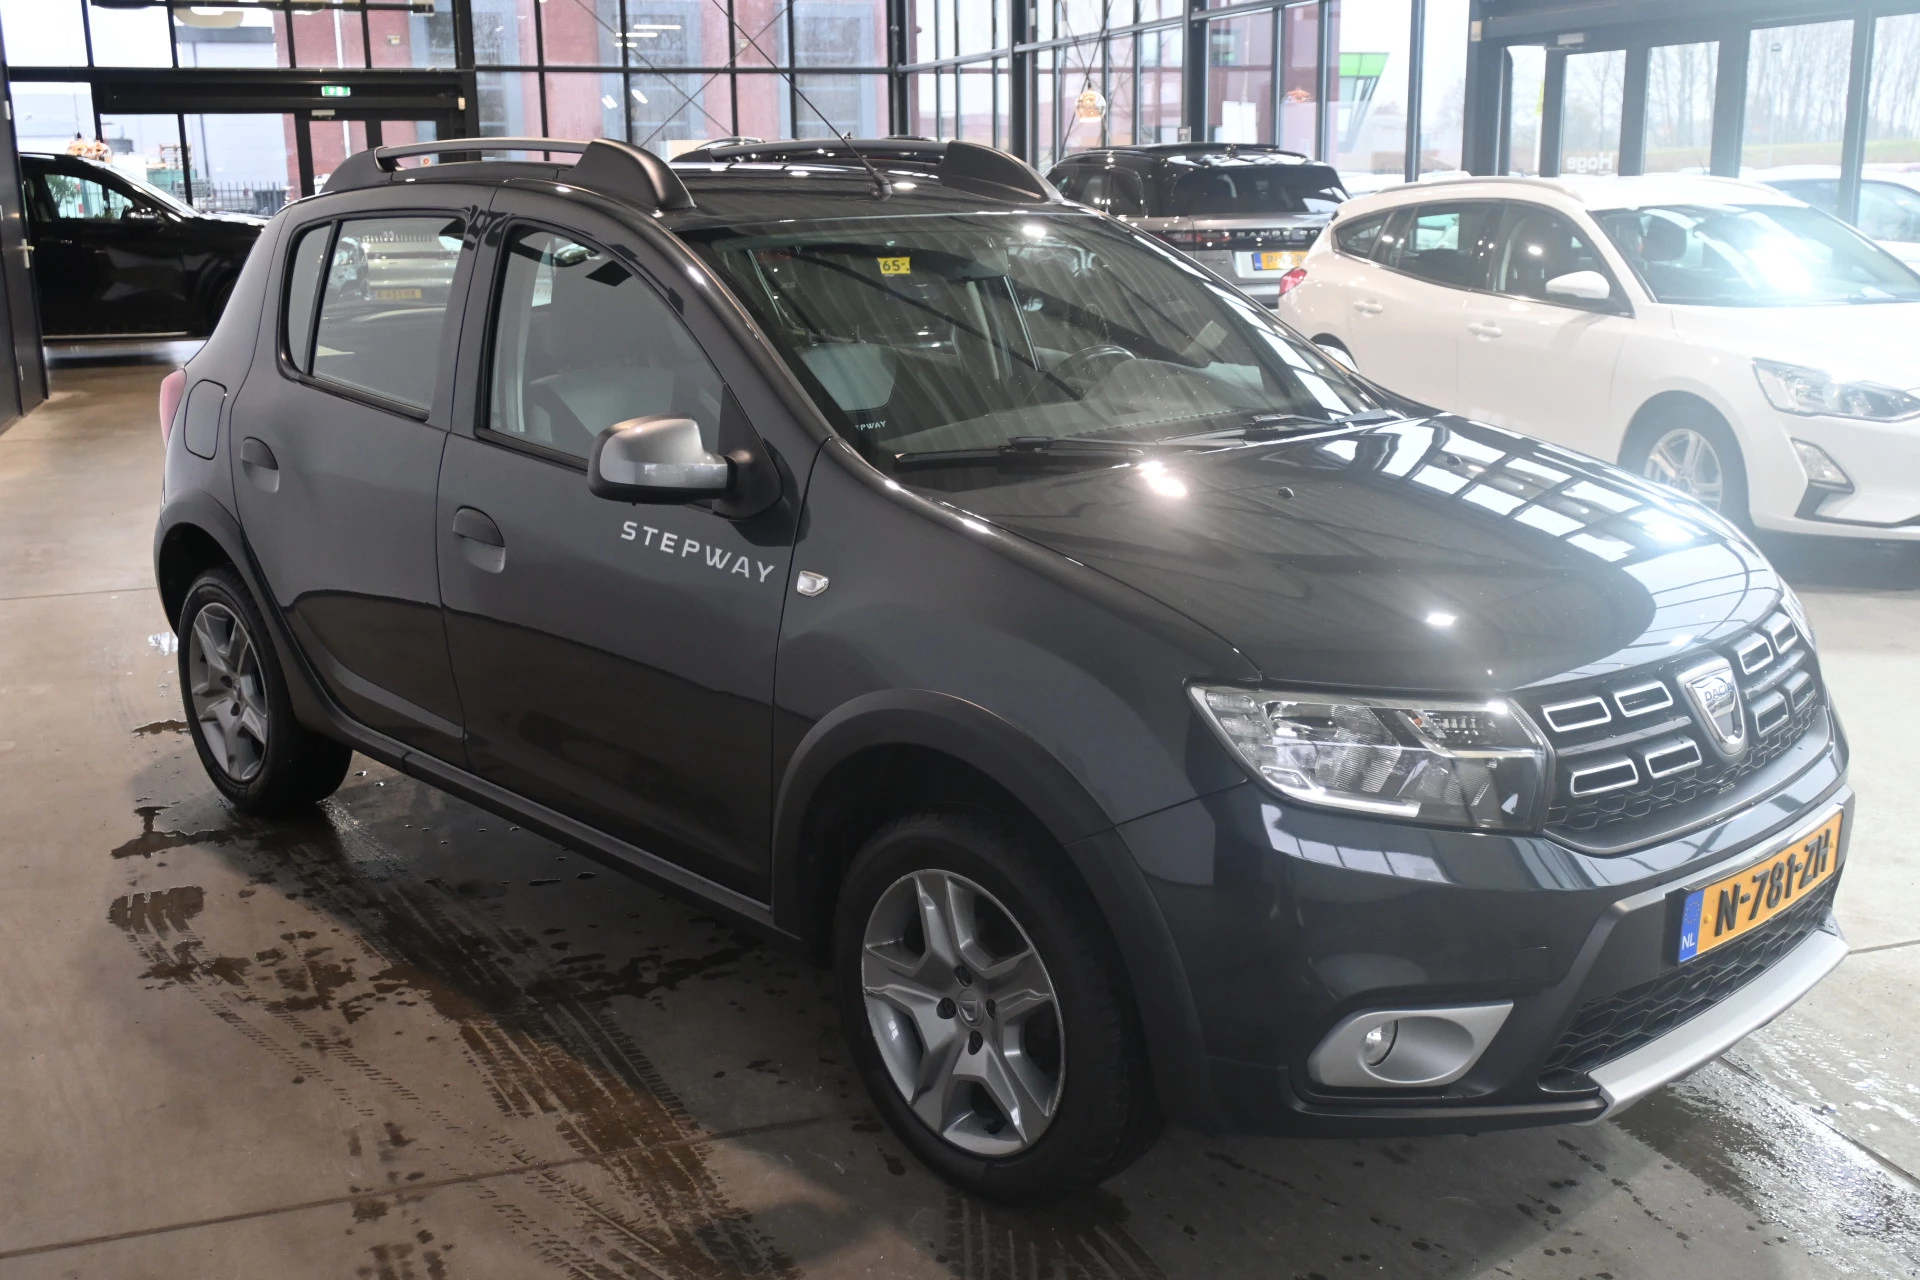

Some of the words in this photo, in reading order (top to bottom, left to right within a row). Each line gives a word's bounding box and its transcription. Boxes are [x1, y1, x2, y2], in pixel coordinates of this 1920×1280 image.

[620, 520, 775, 583] STEPWAY
[1704, 682, 1735, 702] DACIA
[1714, 827, 1831, 937] N-781-ZH
[1681, 932, 1696, 951] NL
